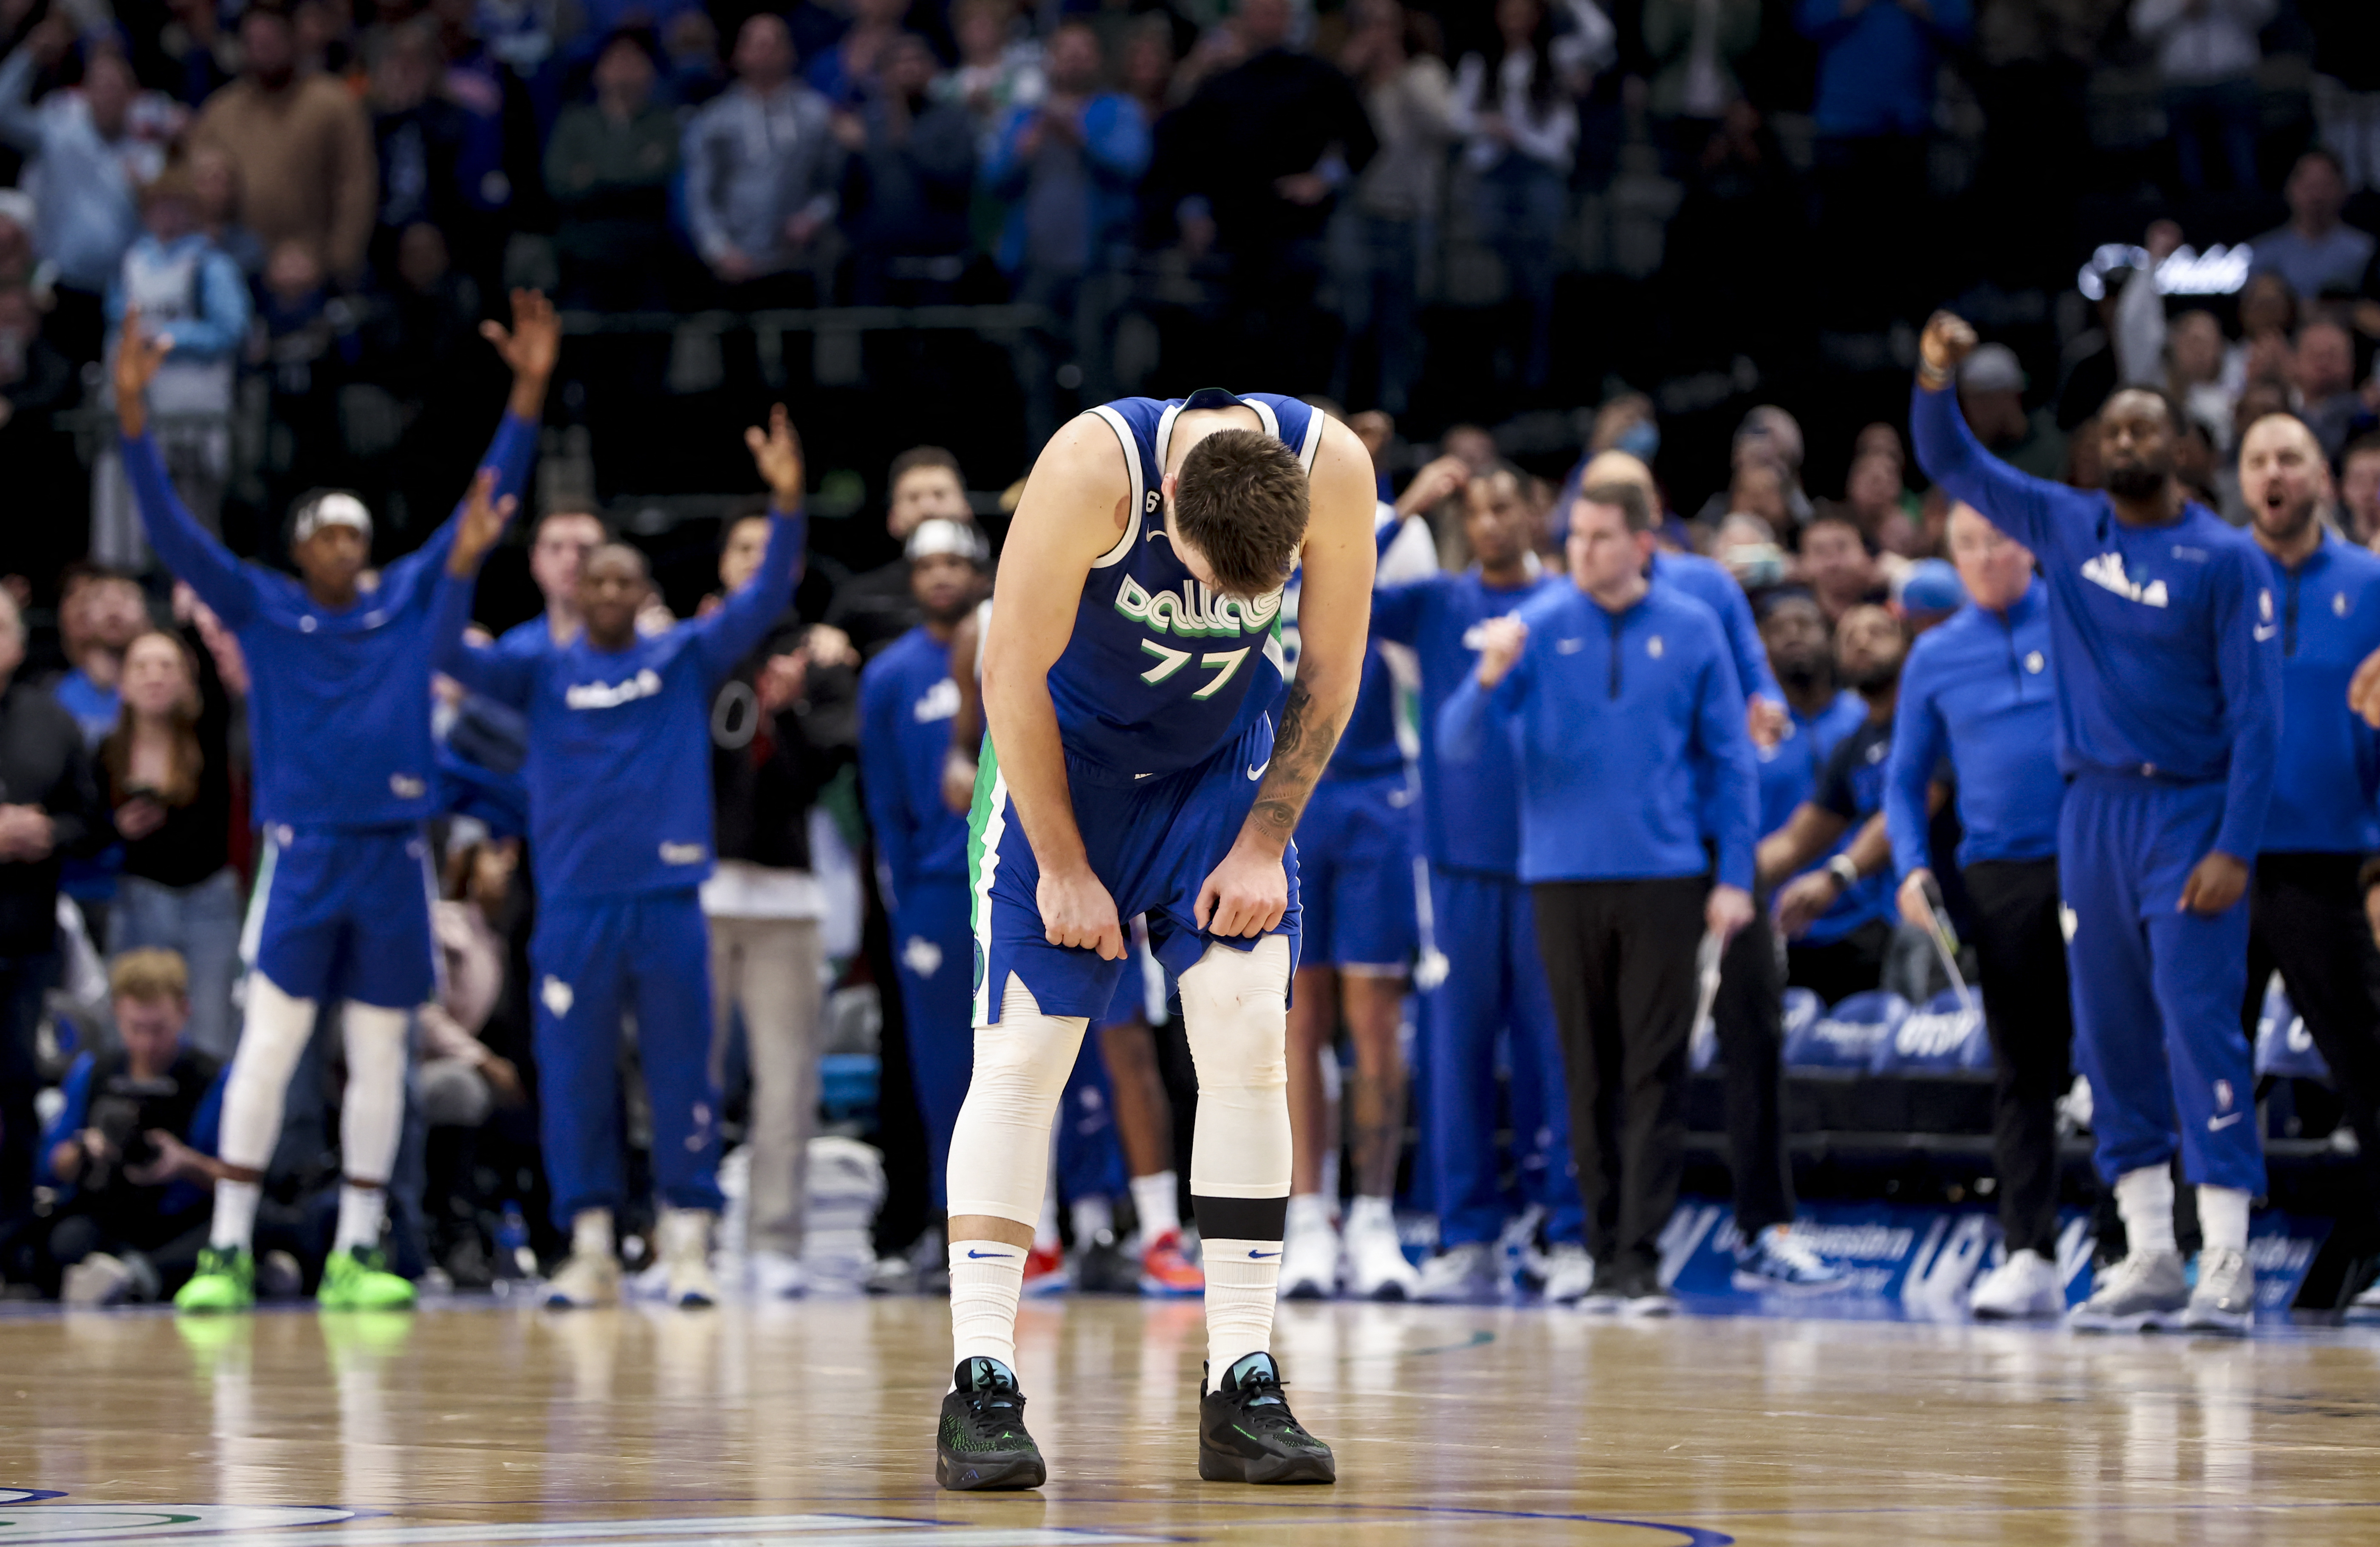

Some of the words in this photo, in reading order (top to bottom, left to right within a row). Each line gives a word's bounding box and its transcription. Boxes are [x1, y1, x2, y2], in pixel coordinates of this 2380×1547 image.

[1146, 490, 1160, 513] 6
[1114, 573, 1284, 638] Dallas
[1140, 638, 1251, 701] 77
